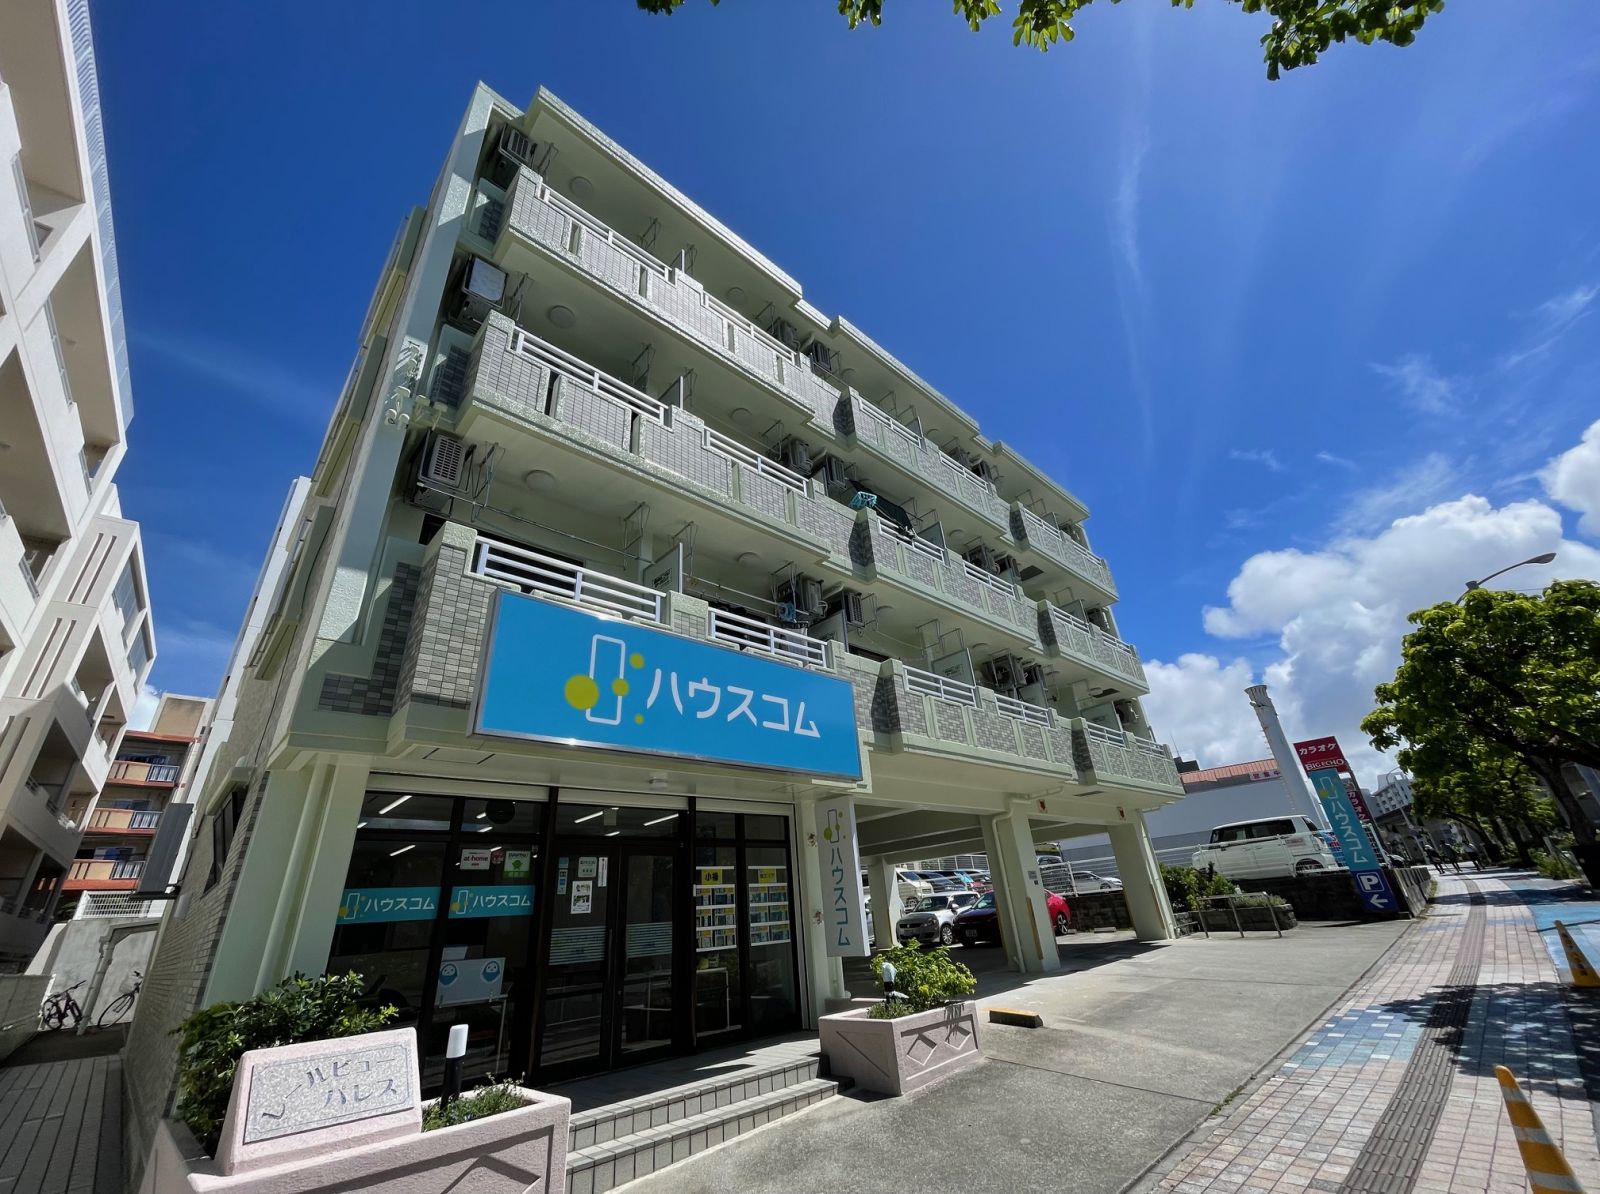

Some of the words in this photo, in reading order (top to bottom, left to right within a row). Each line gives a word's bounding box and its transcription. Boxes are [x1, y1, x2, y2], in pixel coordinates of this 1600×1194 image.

[647, 668, 821, 738] ハウスコム
[1299, 743, 1336, 755] カラオケ
[1305, 762, 1320, 771] BIG
[1321, 758, 1345, 767] ECHO
[1331, 801, 1368, 863] ハウスコム
[1360, 876, 1379, 891] P
[472, 895, 531, 909] ハウスコム
[831, 847, 851, 946] ハウスコム
[364, 897, 435, 912] ハウスコム
[323, 1078, 397, 1109] パレス
